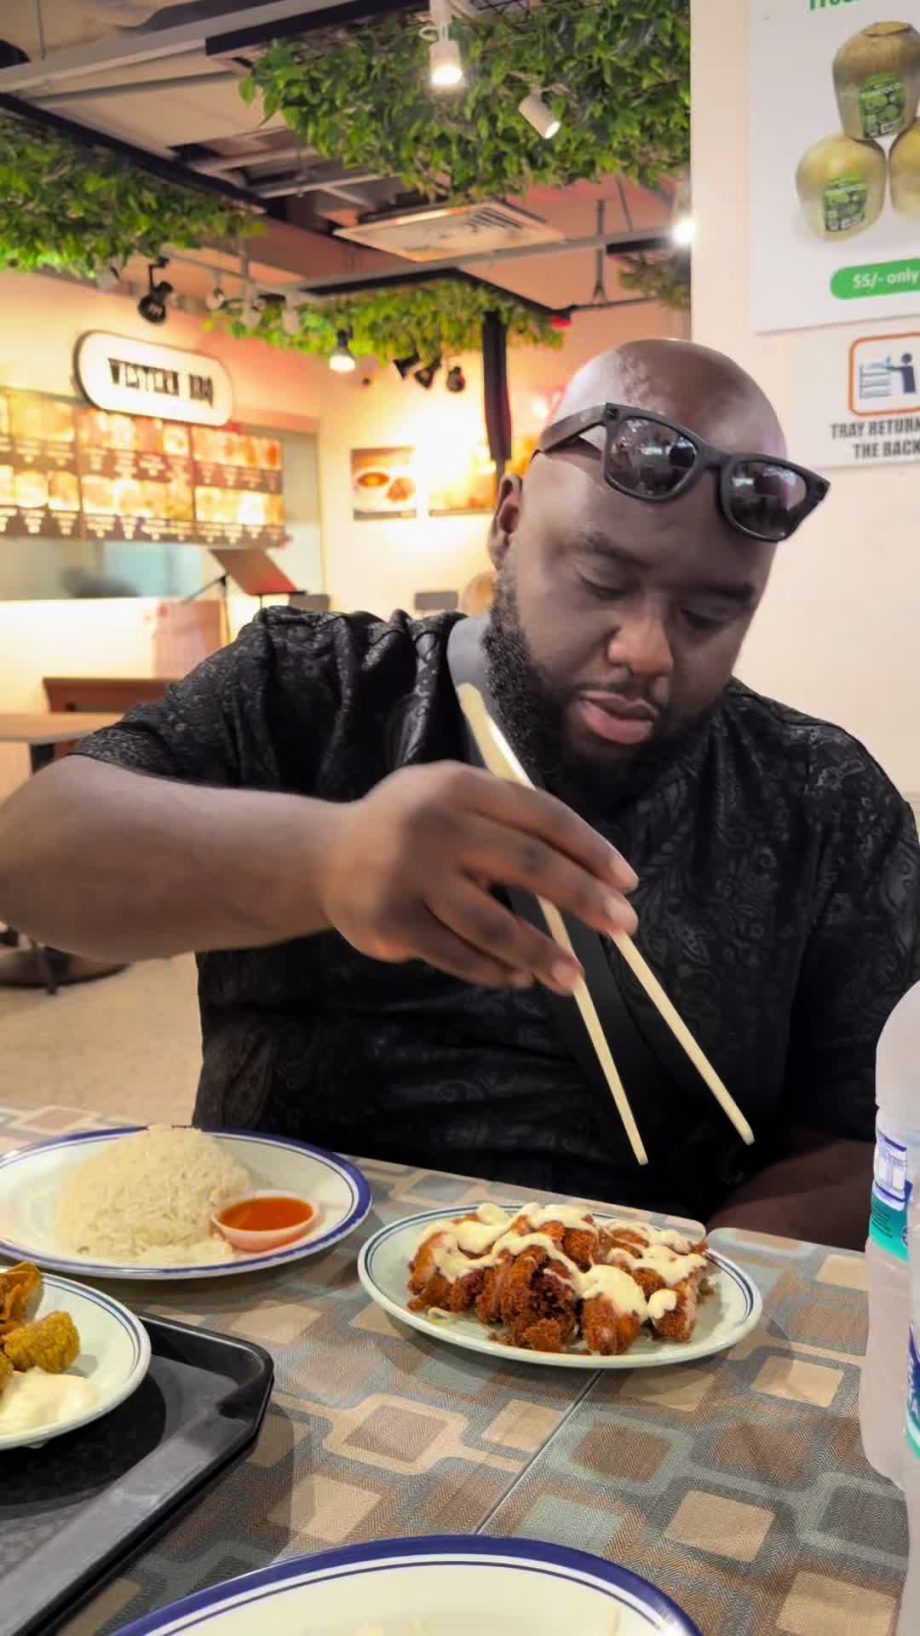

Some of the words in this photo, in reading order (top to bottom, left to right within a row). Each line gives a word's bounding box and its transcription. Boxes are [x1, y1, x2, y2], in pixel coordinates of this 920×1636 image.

[886, 267, 919, 284] only
[107, 357, 179, 397] WESTERN
[189, 374, 213, 408] BBQ
[830, 422, 864, 439] TRAY
[853, 443, 878, 459] THE
[883, 440, 920, 457] BACK
